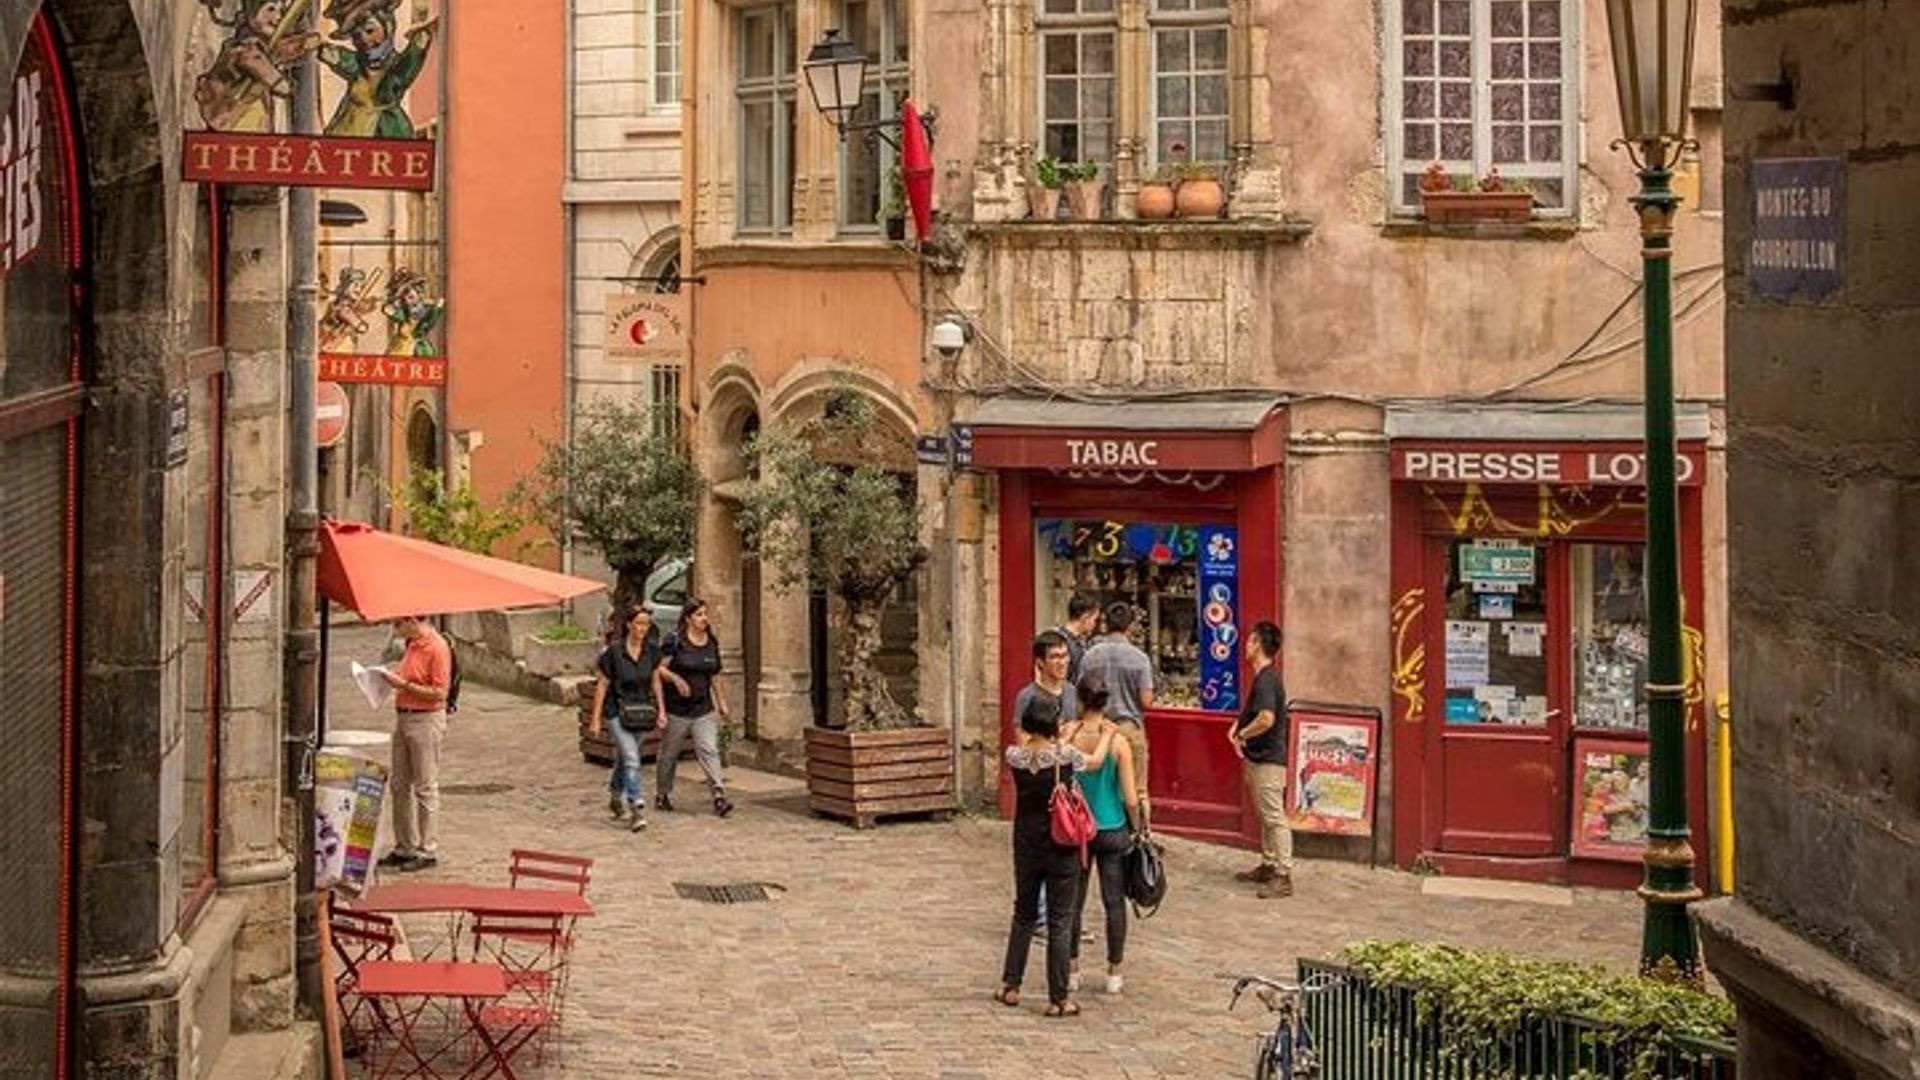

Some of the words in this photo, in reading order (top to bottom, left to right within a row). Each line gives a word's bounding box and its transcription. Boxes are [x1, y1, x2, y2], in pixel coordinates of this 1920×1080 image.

[192, 140, 429, 178] THÉÂTRE
[1812, 186, 1831, 216] DU
[1066, 440, 1158, 465] TABAC
[1405, 453, 1561, 480] PRESSE
[1588, 453, 1694, 481] LOO
[1097, 521, 1124, 557] 3
[1203, 679, 1220, 702] 5
[1223, 671, 1234, 688] 2
